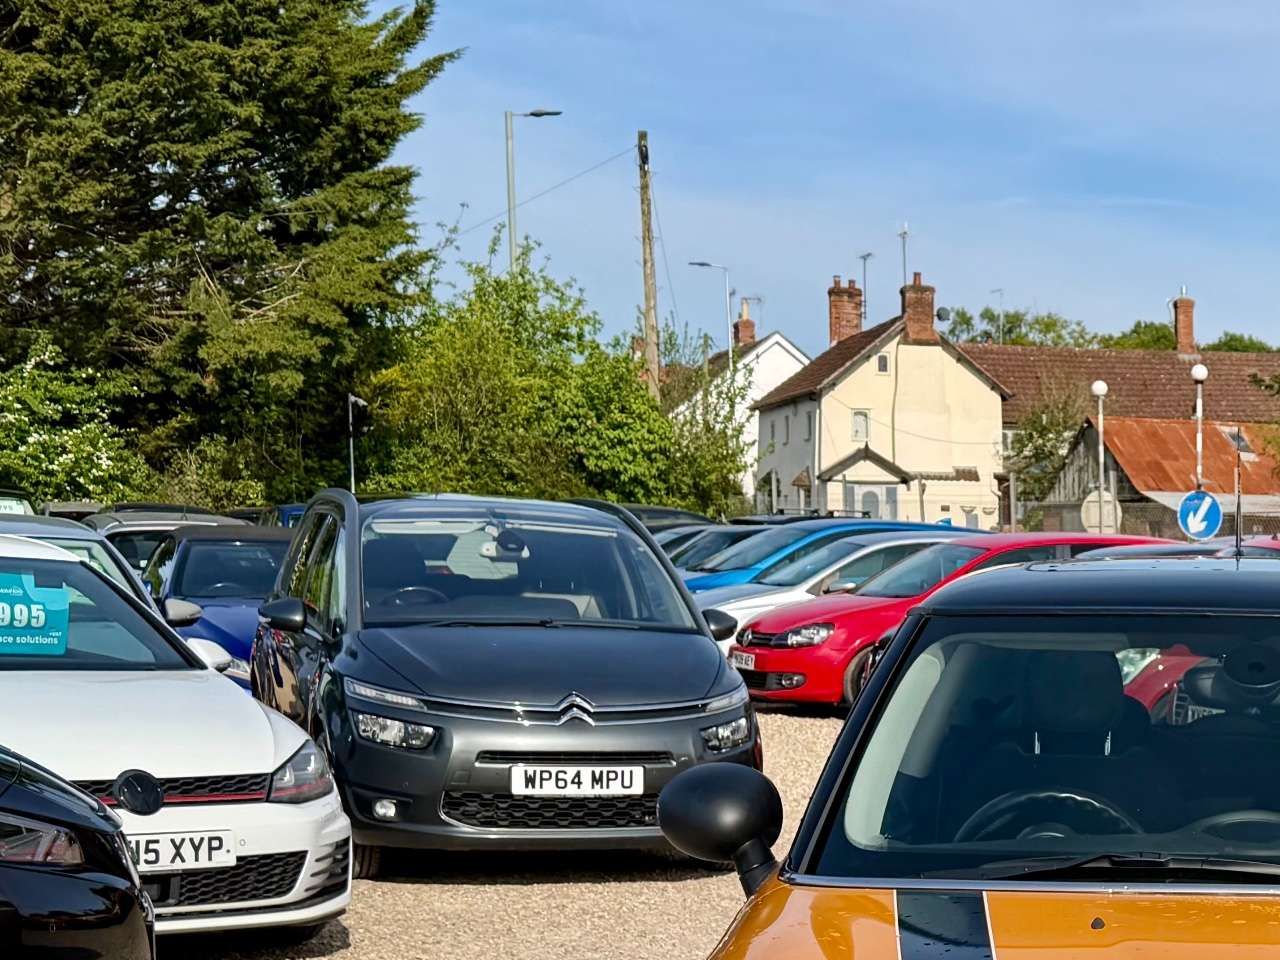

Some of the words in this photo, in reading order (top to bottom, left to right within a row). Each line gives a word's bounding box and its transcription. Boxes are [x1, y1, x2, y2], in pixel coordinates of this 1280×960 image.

[16, 633, 58, 645] solutions
[524, 769, 583, 790] WP64
[591, 769, 634, 790] MPU
[169, 836, 224, 864] XYP
